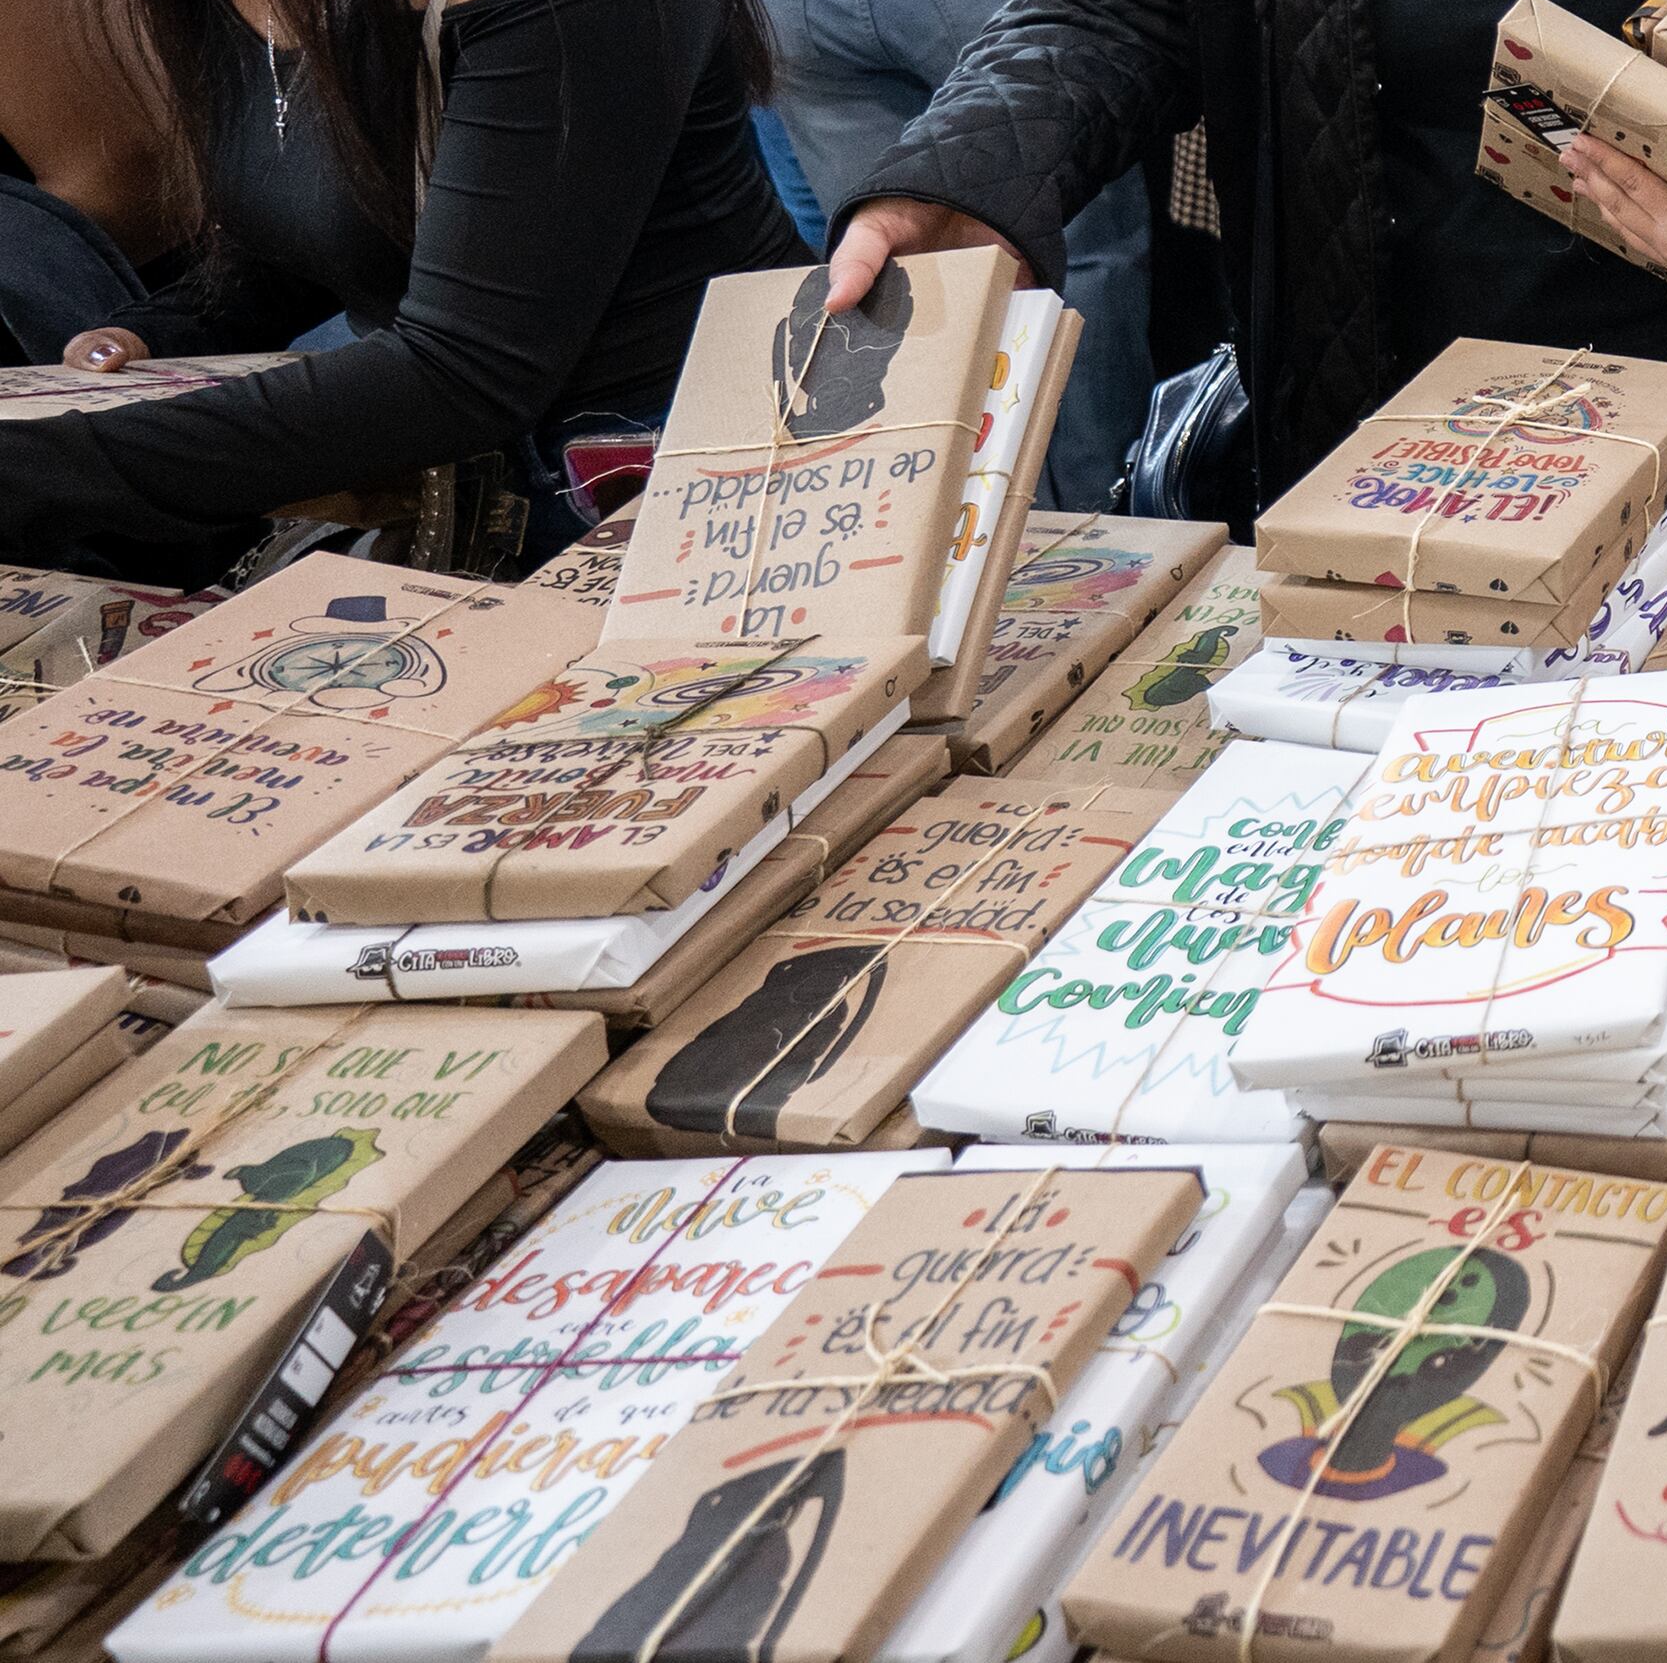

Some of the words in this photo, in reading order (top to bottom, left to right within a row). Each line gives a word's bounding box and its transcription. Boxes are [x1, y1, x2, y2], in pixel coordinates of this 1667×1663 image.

[838, 457, 877, 492] la
[890, 448, 937, 479] de
[1397, 462, 1490, 489] HACE
[1348, 477, 1483, 519] AMOR
[702, 516, 758, 560] fin
[768, 507, 808, 538] el
[702, 539, 841, 606] guerra
[1017, 626, 1057, 640] DEL
[702, 742, 749, 759] DEL
[206, 790, 281, 826] El
[401, 786, 709, 829] FUERZA
[363, 832, 417, 854] LA
[421, 832, 461, 850] ES
[461, 823, 609, 855] AMOR
[623, 823, 668, 849] EL
[916, 819, 1063, 856] guerra
[1328, 826, 1504, 879] donde
[979, 857, 1036, 894] fin
[1365, 1146, 1428, 1194] EL
[1428, 1202, 1550, 1254] es
[890, 1247, 1060, 1312] guerra
[964, 1294, 1040, 1349] fin
[373, 1400, 475, 1428] antes
[1112, 1492, 1499, 1605] INEVITABLE
